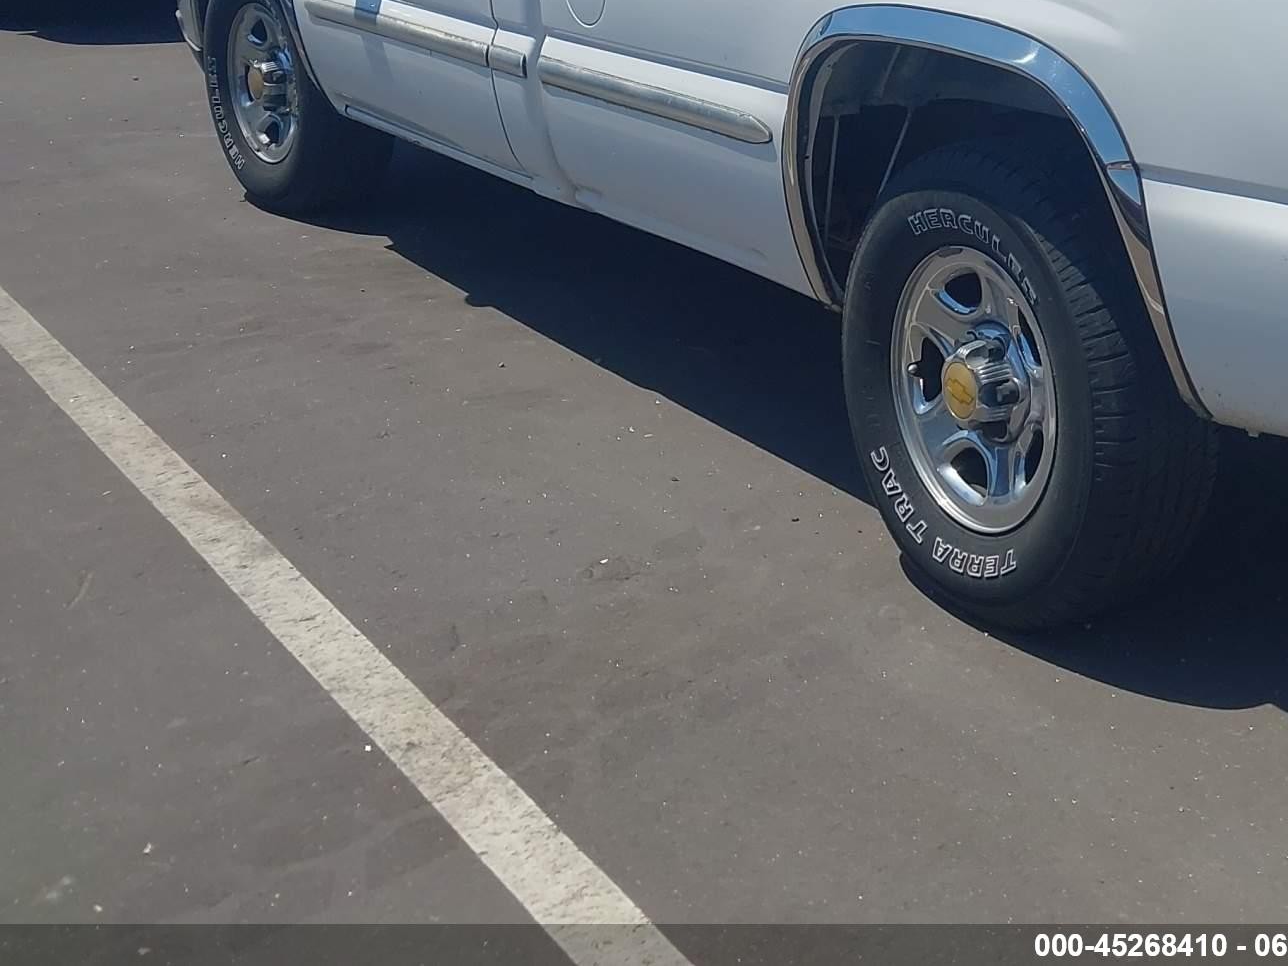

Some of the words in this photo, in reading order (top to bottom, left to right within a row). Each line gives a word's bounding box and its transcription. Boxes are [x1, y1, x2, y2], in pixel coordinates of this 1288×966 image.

[907, 208, 1038, 306] HERCULES
[870, 446, 928, 544] TRAC
[932, 536, 1017, 578] TERRA
